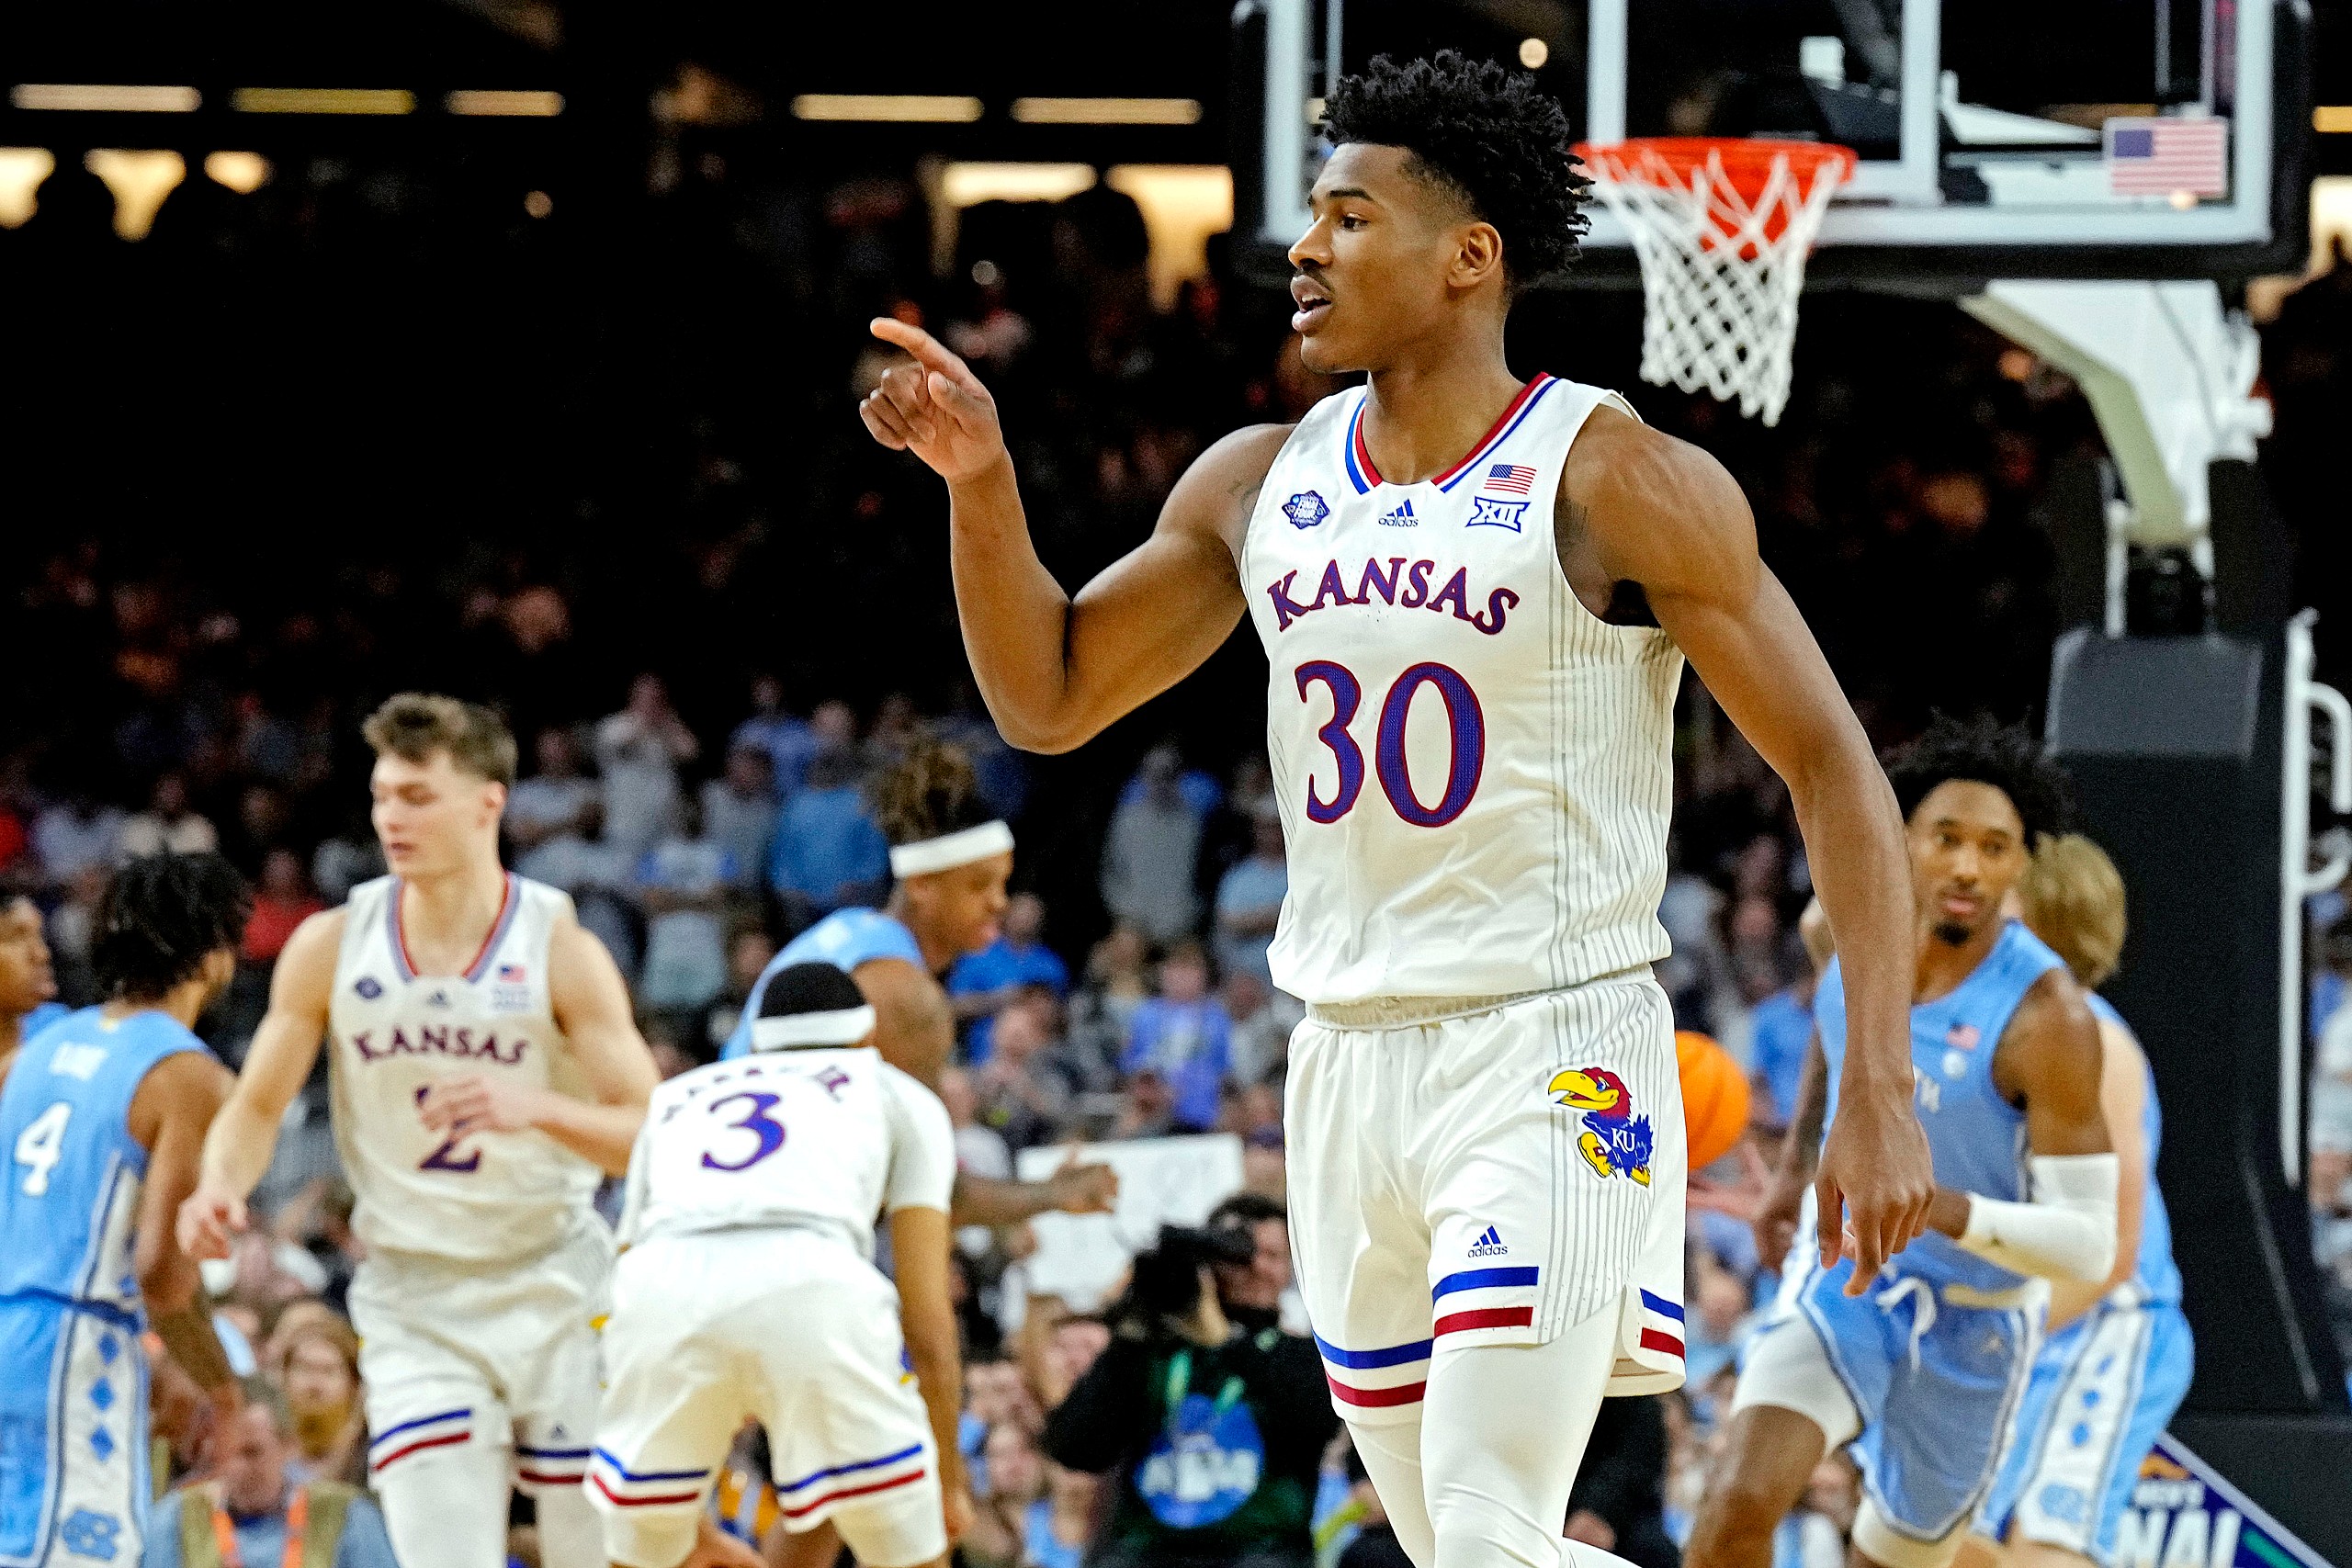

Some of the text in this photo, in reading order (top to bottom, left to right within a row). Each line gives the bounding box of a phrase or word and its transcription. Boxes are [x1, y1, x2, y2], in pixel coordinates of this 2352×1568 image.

[1378, 516, 1419, 527] adidas
[1267, 557, 1521, 635] KANSAS
[1295, 660, 1486, 828] 30
[354, 1021, 529, 1066] KANSAS
[15, 1101, 73, 1198] 4
[414, 1086, 483, 1173] 2
[700, 1090, 786, 1173] 3
[1611, 1127, 1636, 1153] KU
[1467, 1244, 1509, 1258] adidas
